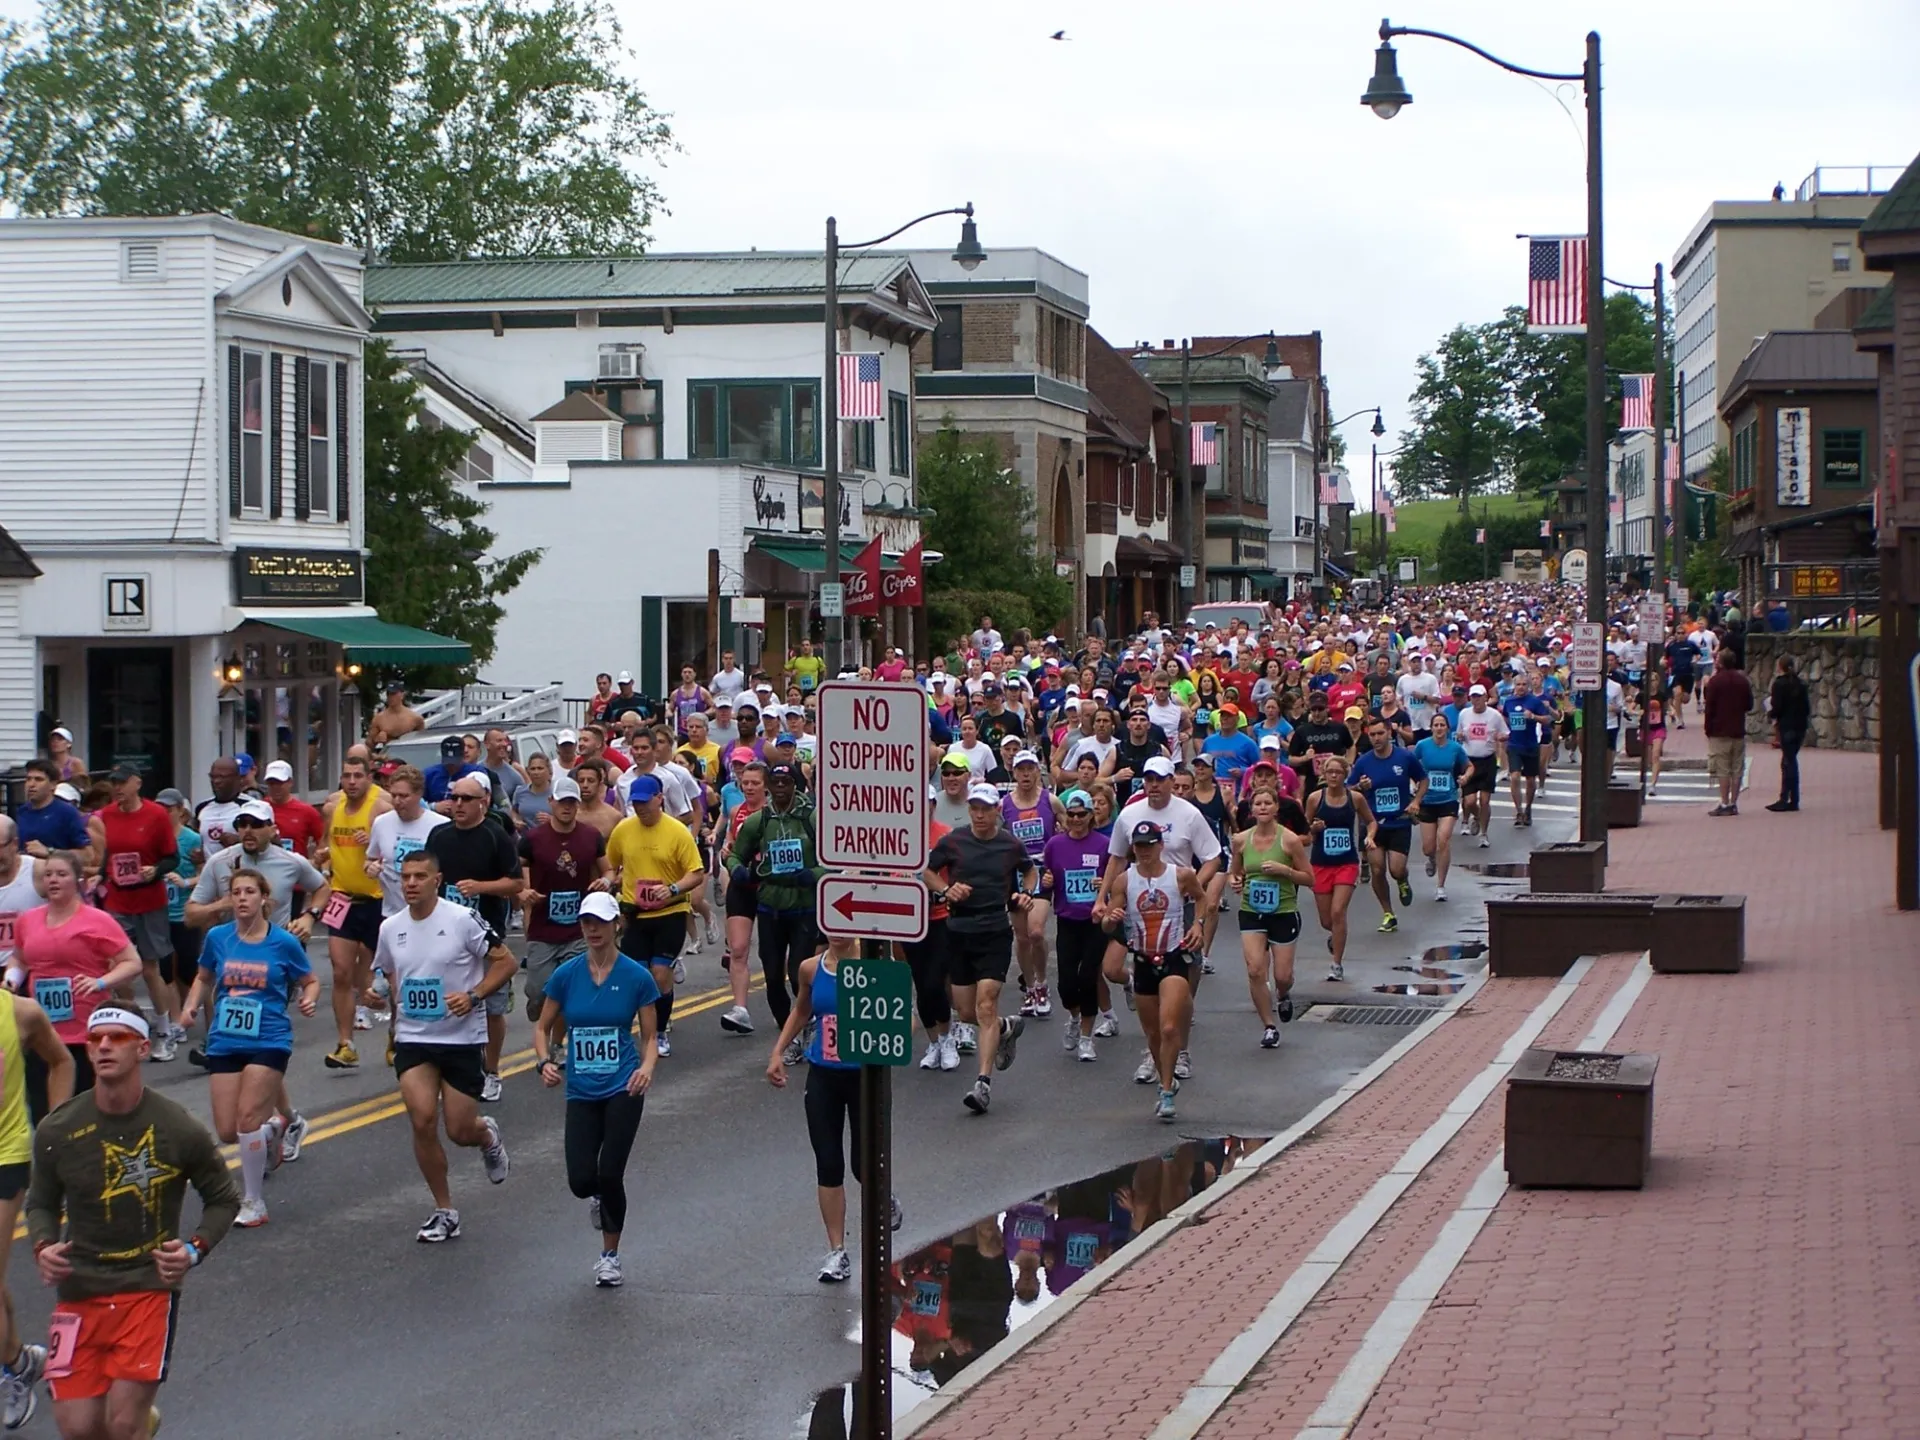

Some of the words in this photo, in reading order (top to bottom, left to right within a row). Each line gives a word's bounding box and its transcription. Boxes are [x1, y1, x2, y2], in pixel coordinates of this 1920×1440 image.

[1583, 627, 1593, 636] NO
[853, 698, 890, 732] NO
[829, 741, 915, 772] STOPPING
[830, 783, 914, 815] STANDING
[1377, 794, 1399, 806] 2008
[834, 825, 909, 857] PARKING
[1325, 835, 1351, 849] 1508
[771, 848, 802, 865] 1880
[640, 888, 662, 902] 40
[1253, 890, 1275, 905] 951
[551, 900, 580, 916] 2459
[843, 965, 868, 989] 86
[37, 990, 71, 1010] 1400
[408, 990, 438, 1010] 999
[849, 996, 904, 1020] 1202
[226, 1008, 255, 1031] 750
[575, 1040, 618, 1062] 1046
